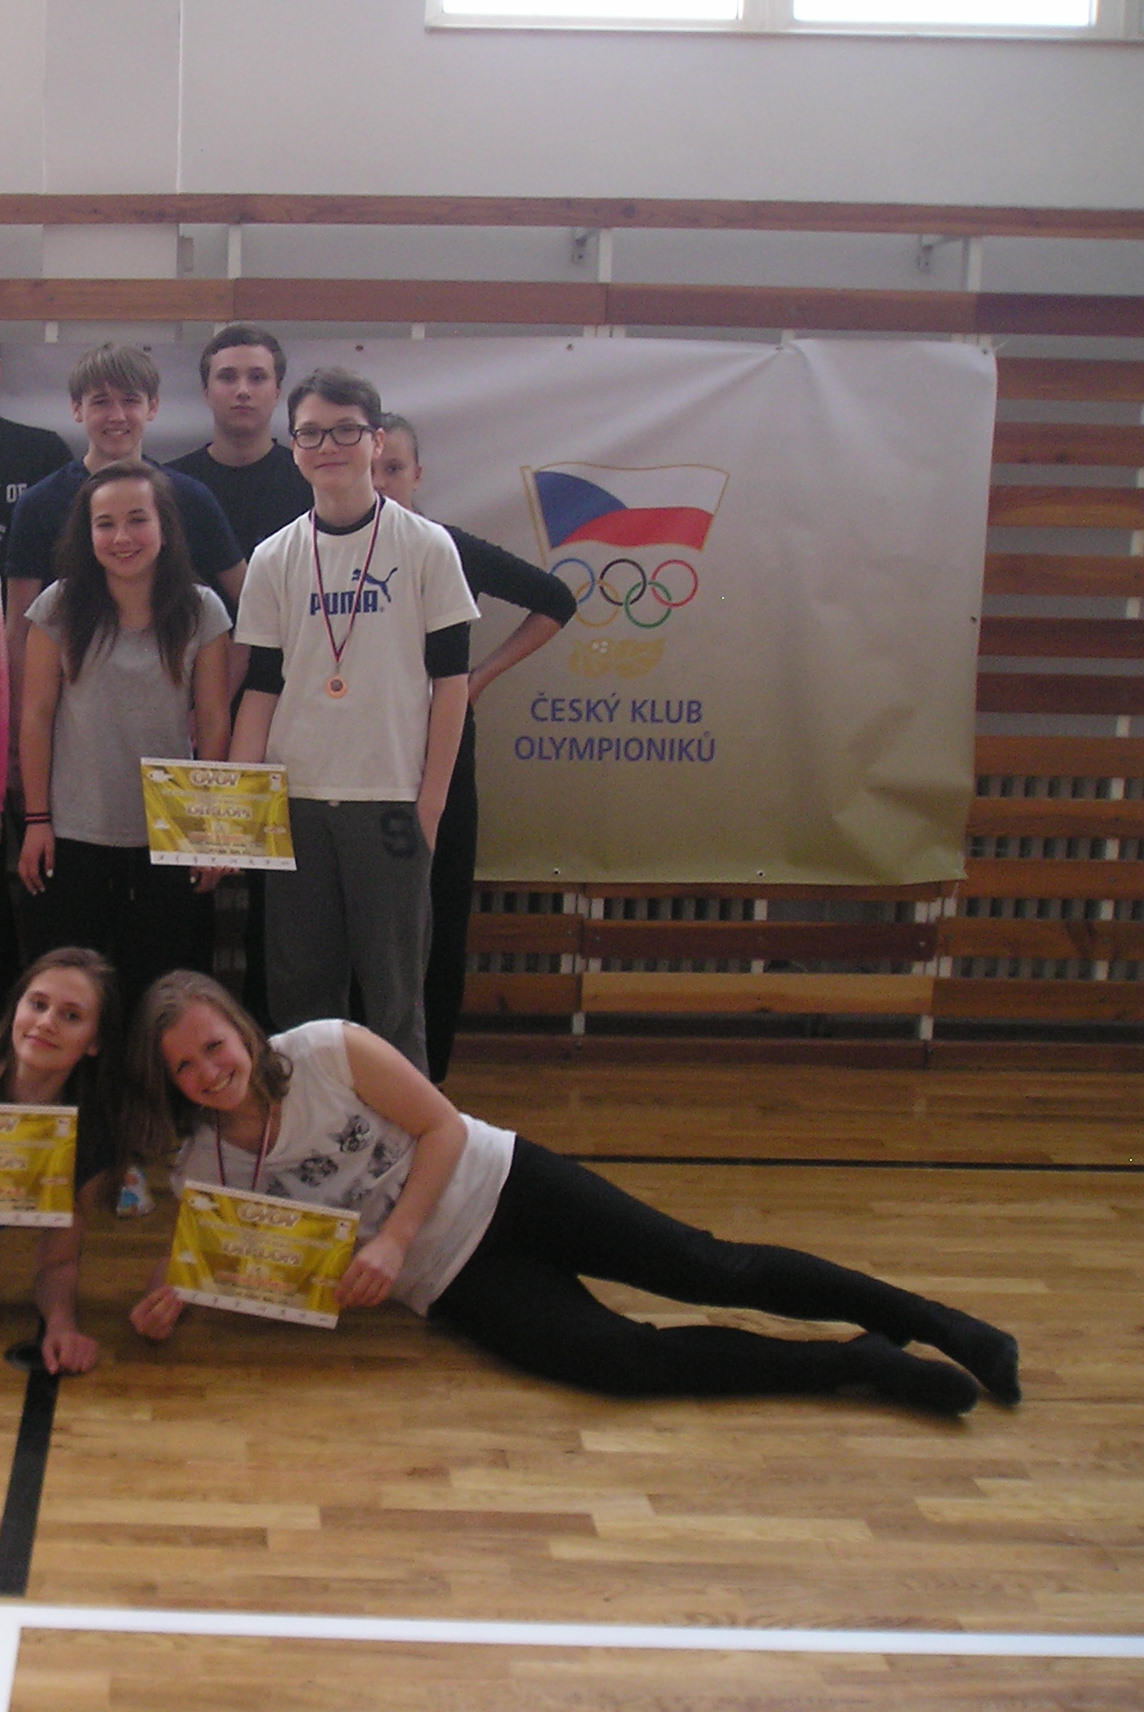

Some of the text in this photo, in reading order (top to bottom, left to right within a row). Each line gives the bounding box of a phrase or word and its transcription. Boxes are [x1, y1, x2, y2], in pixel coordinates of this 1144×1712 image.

[310, 590, 378, 616] PUMA
[530, 692, 704, 724] ČESKÝ KLUB
[514, 731, 717, 763] OLYMPIONIKŮ
